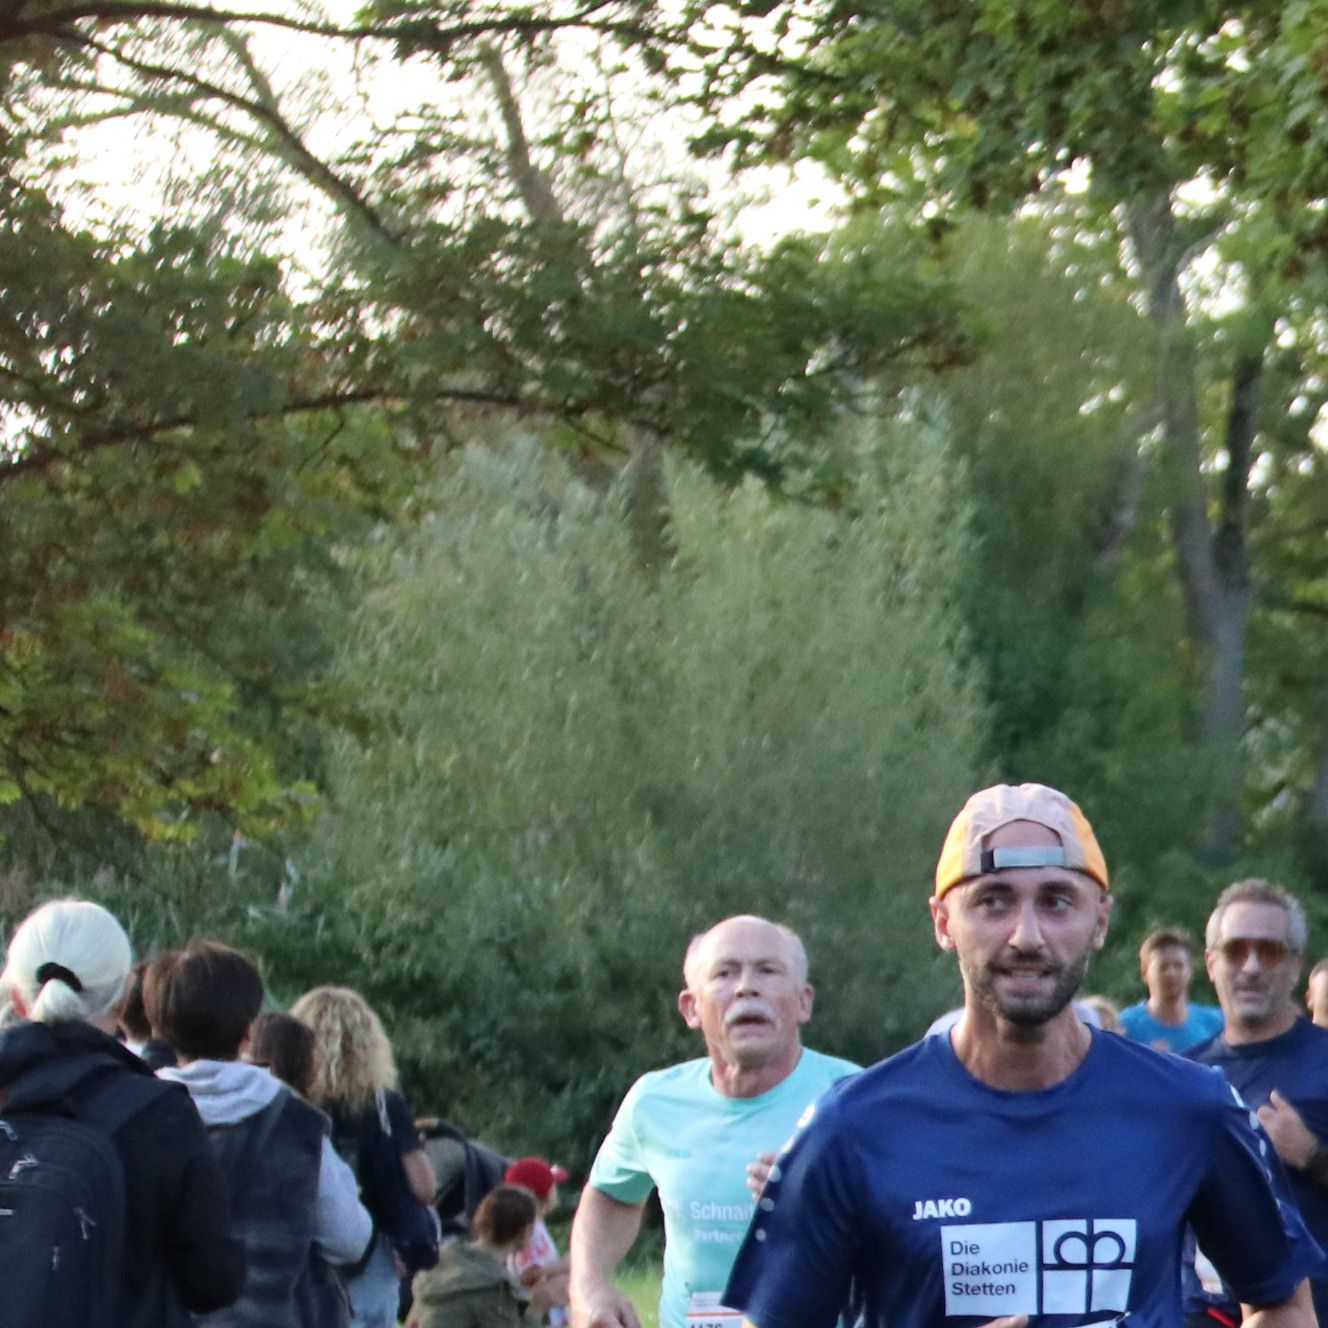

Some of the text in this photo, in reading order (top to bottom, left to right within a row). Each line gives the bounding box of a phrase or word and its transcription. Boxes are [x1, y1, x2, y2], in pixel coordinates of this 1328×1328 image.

[912, 1197, 972, 1220] JAKO
[949, 1240, 980, 1256] Die
[951, 1259, 1029, 1276] Diakonie
[951, 1281, 1016, 1297] Stetten
